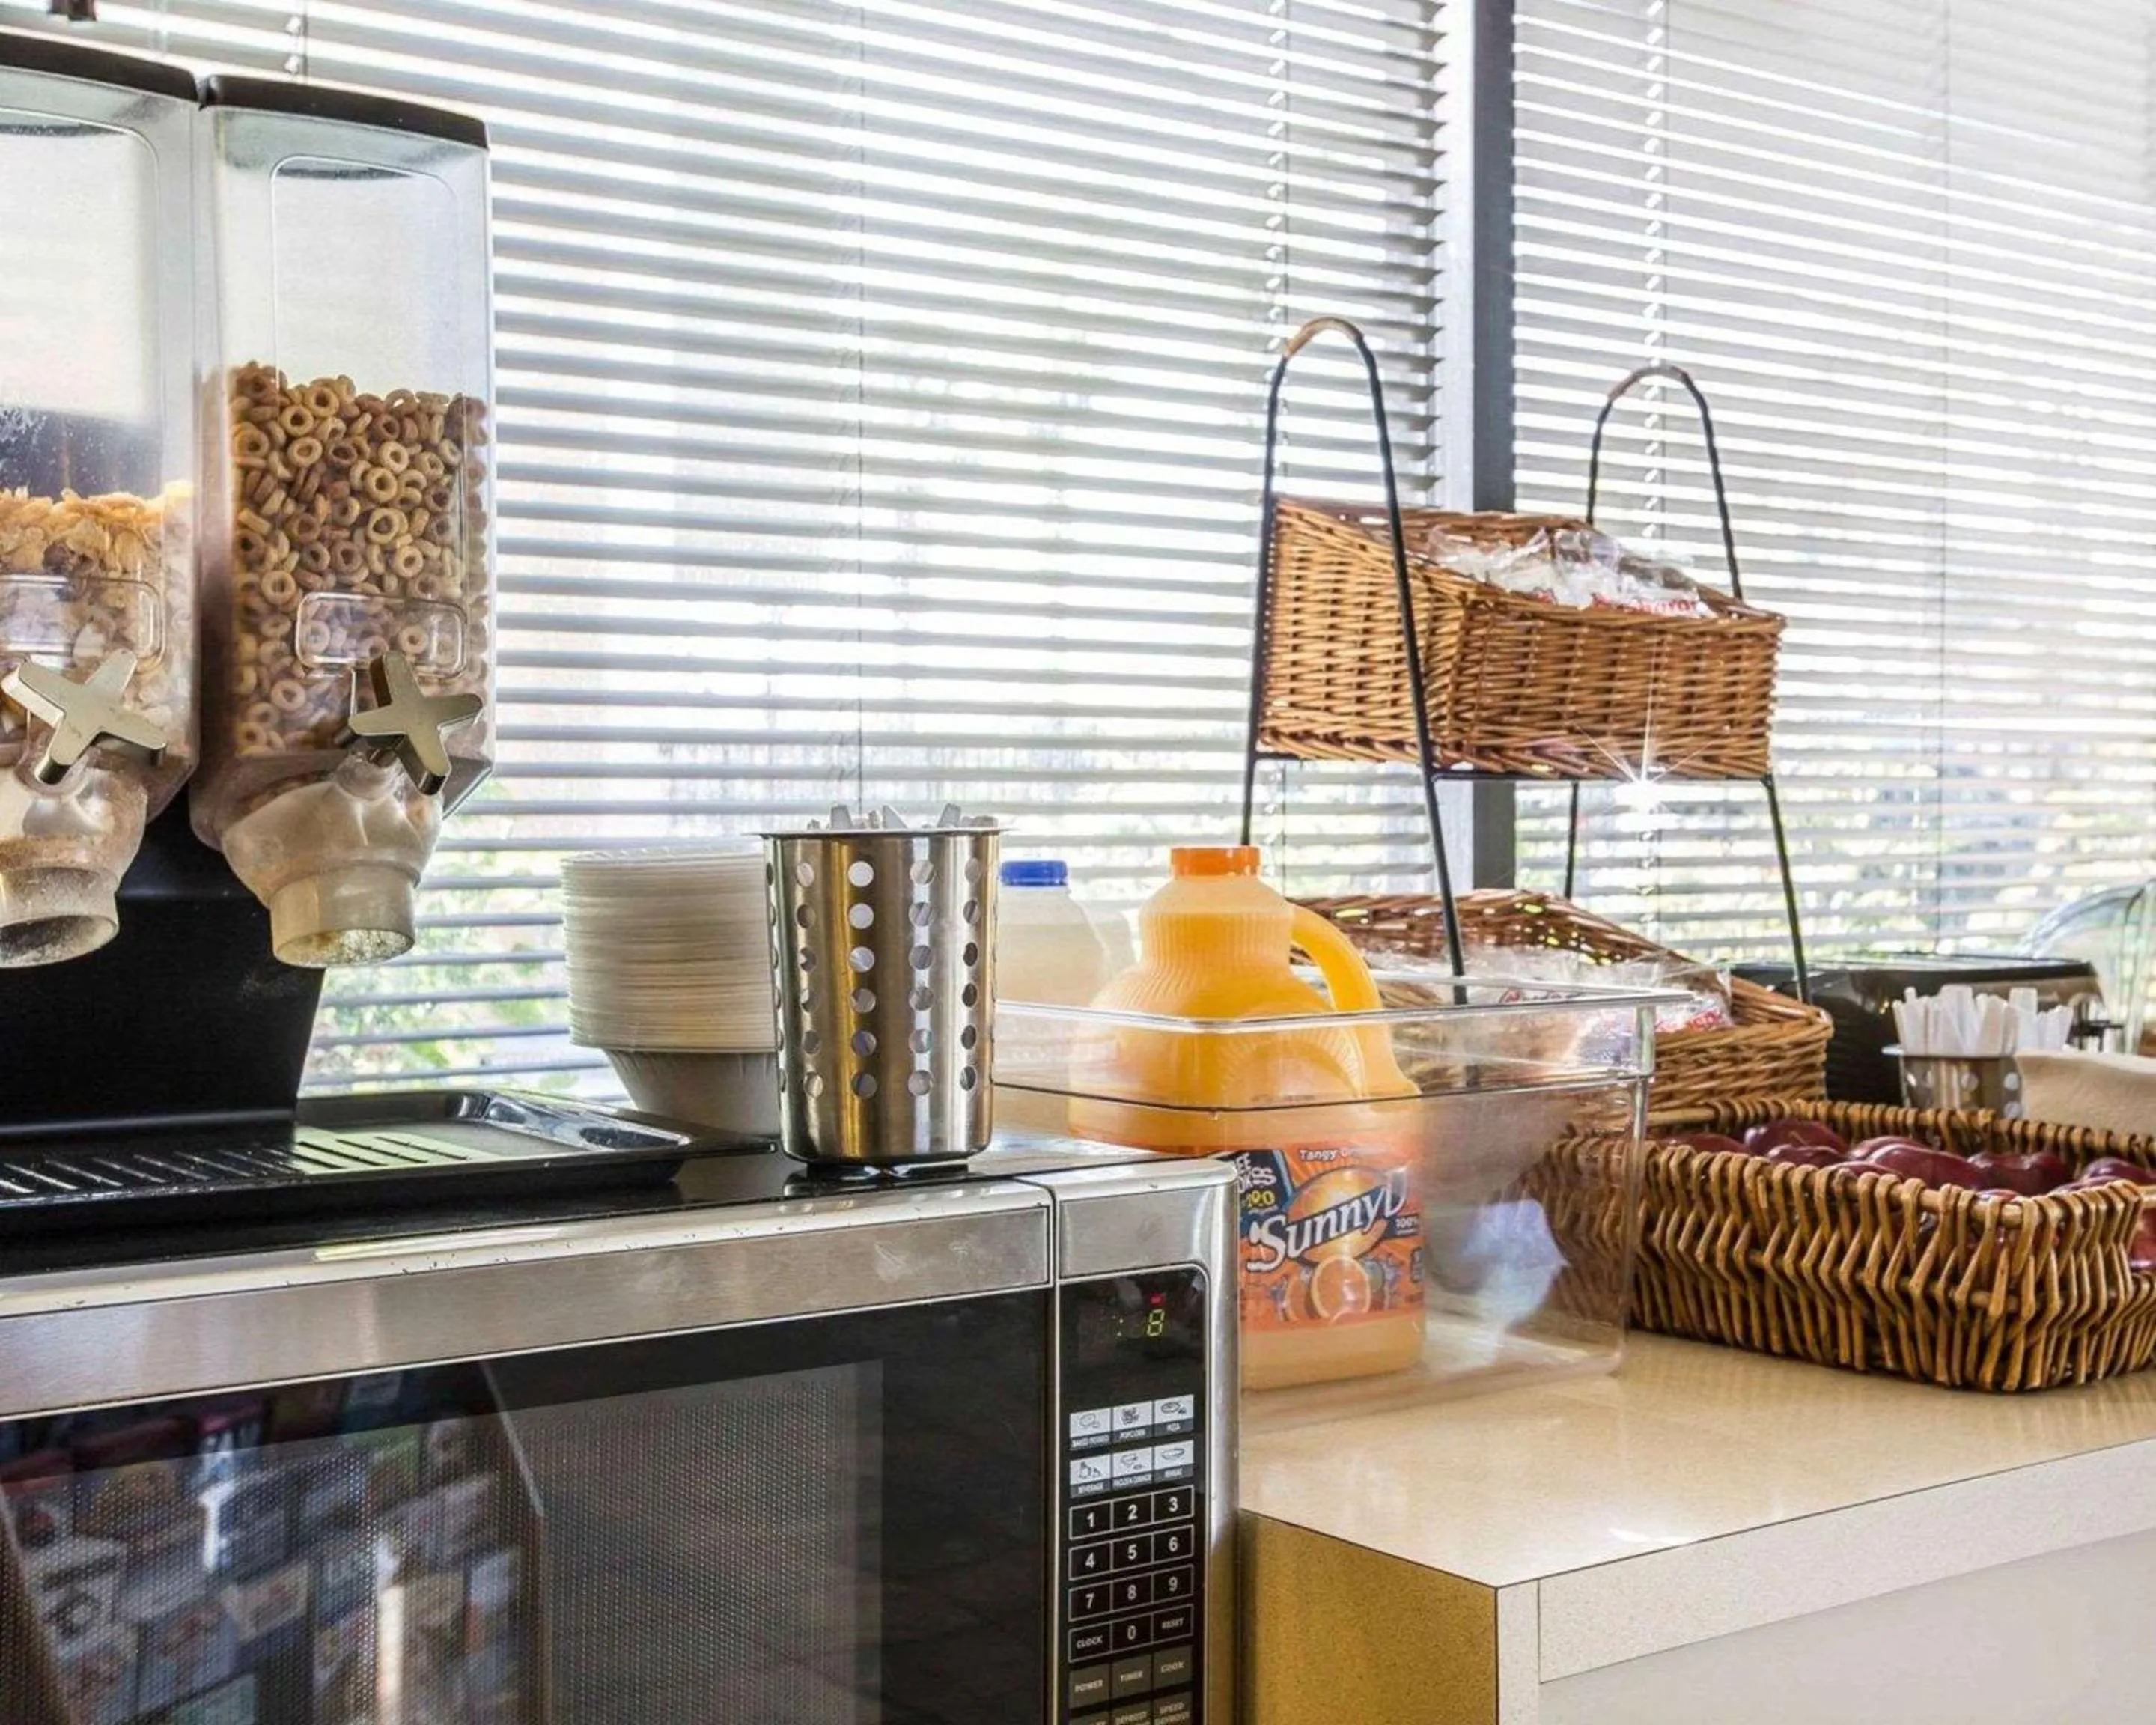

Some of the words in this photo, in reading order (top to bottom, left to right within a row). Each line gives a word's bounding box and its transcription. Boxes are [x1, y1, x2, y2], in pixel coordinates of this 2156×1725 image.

[1299, 1149, 1337, 1160] Tangy
[1169, 1497, 1178, 1512] 3
[1087, 1512, 1095, 1528] 1
[1127, 1505, 1138, 1521] 2
[1169, 1536, 1178, 1552] 6
[1085, 1552, 1095, 1568] 4
[1127, 1545, 1137, 1560] 5
[1169, 1576, 1178, 1592] 9
[1085, 1593, 1094, 1609] 7
[1127, 1585, 1137, 1601] 8
[1127, 1625, 1136, 1640] 0
[1077, 1636, 1103, 1648] CLOCK
